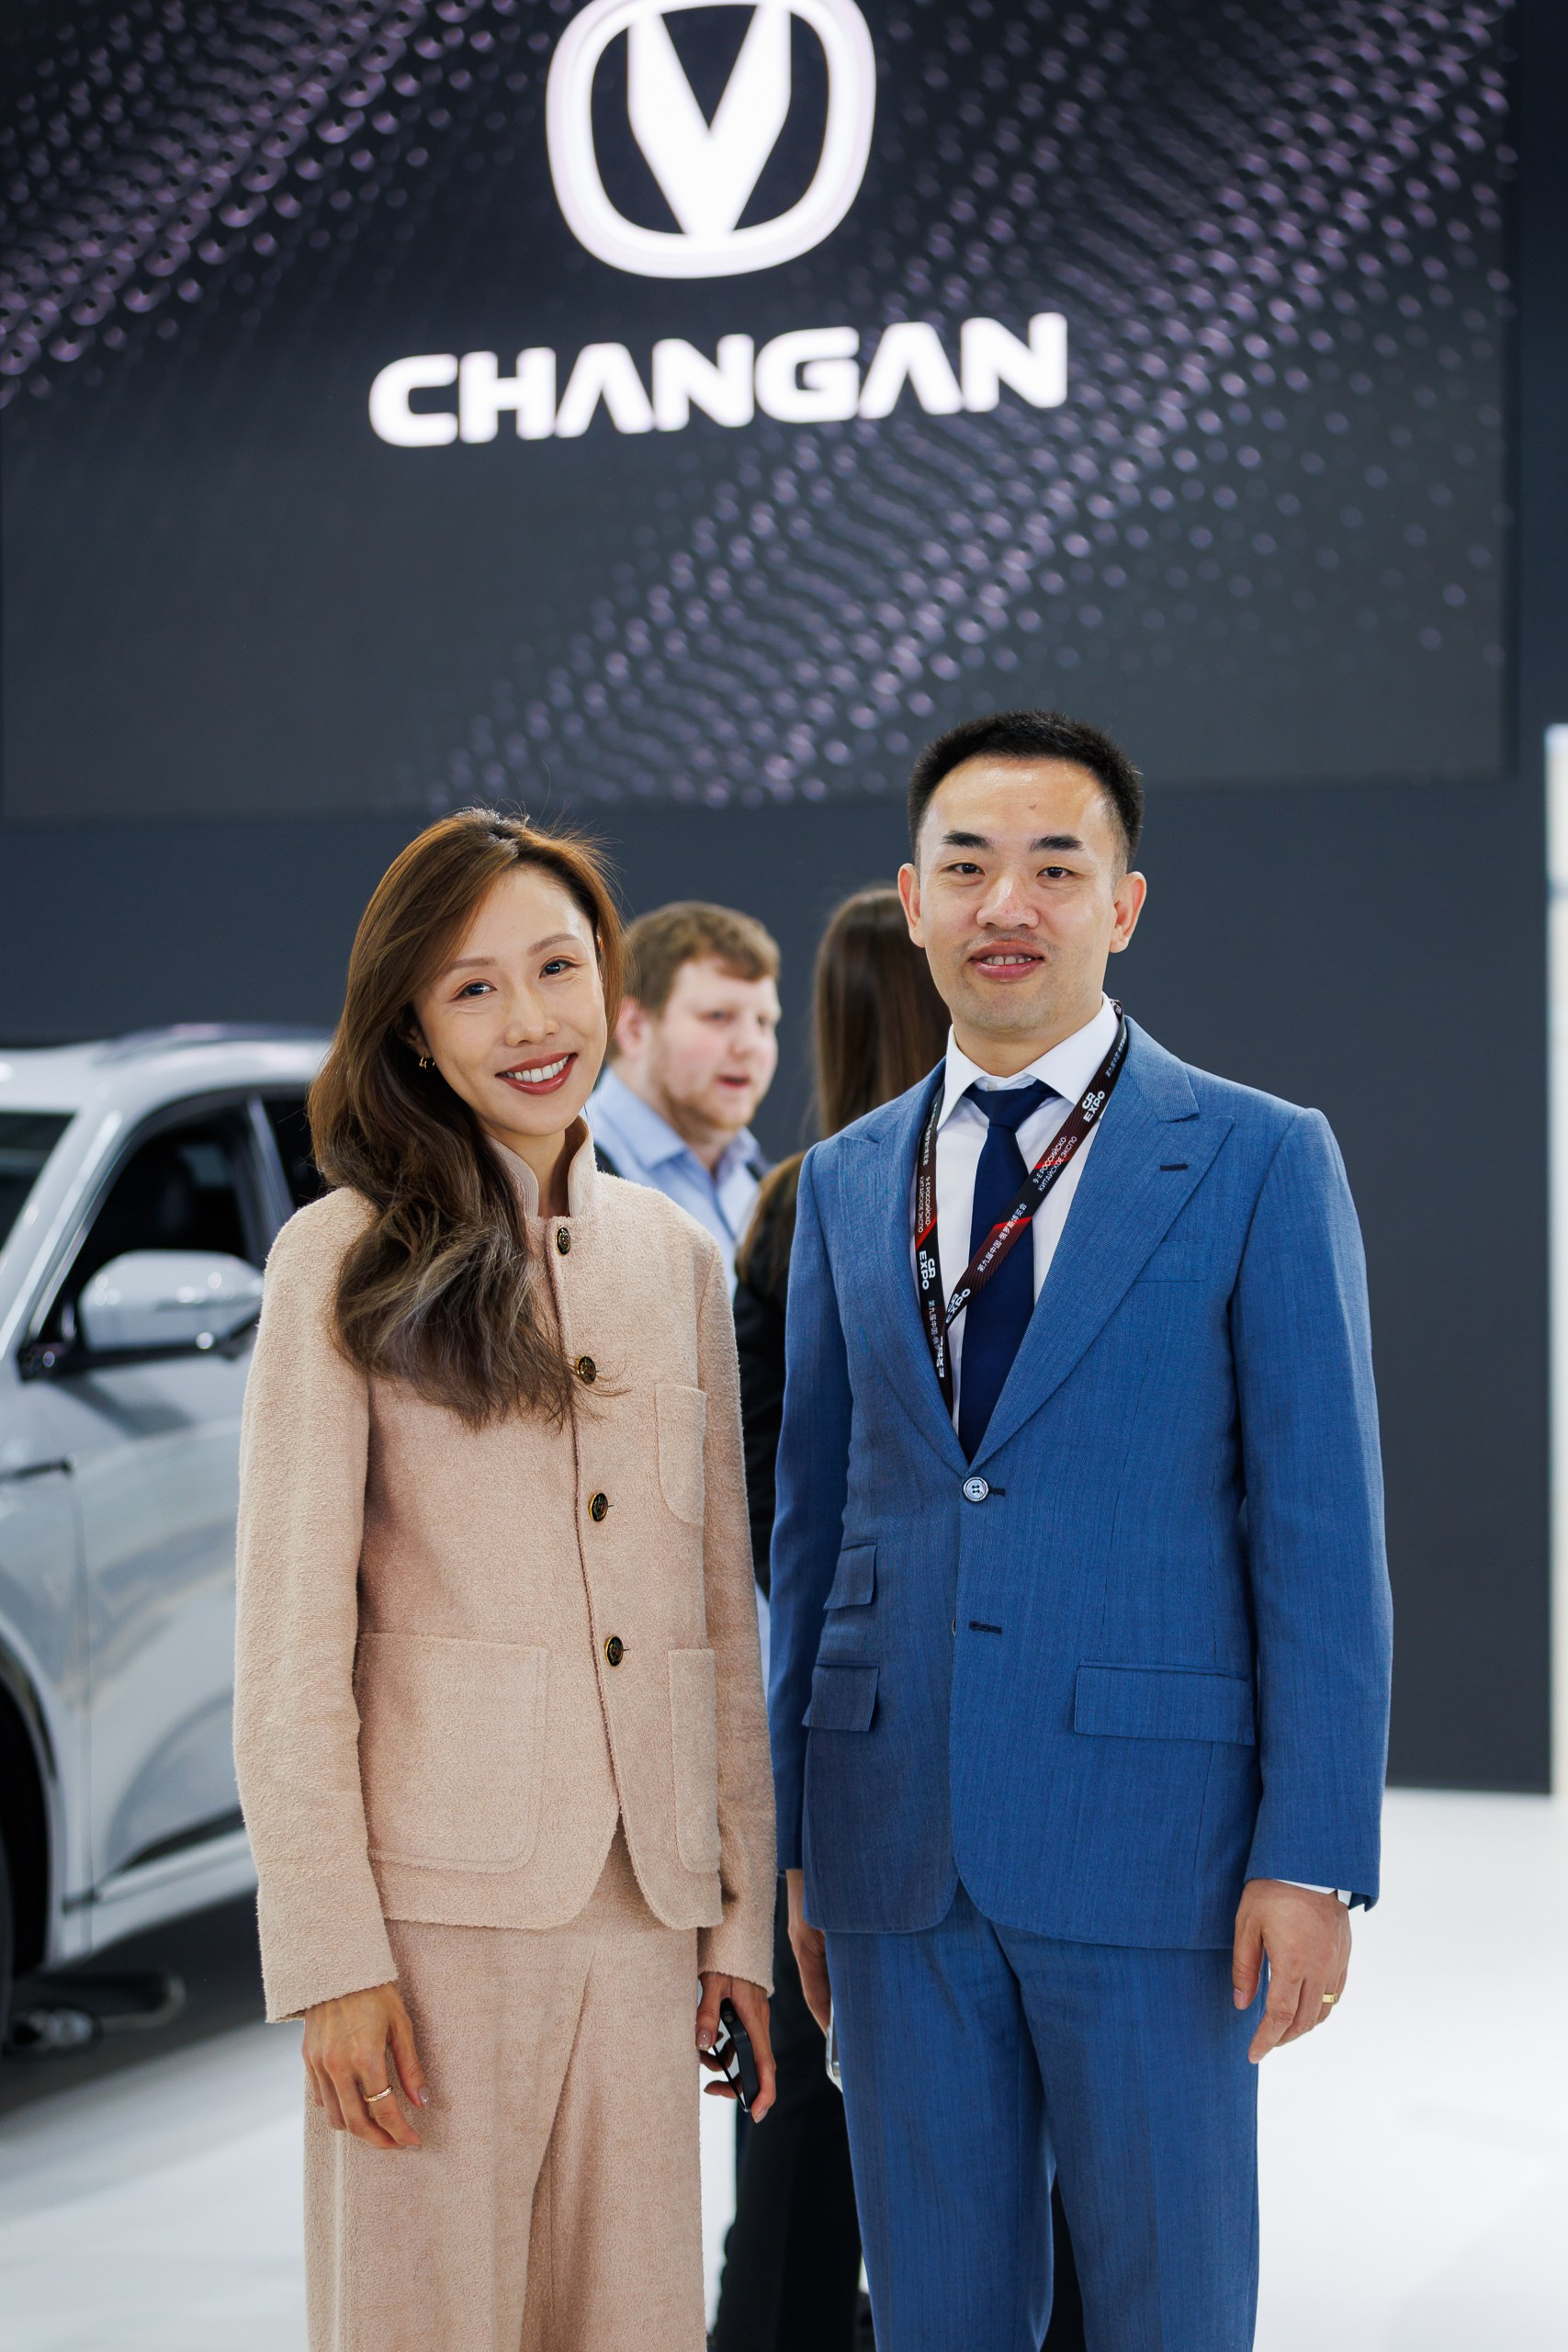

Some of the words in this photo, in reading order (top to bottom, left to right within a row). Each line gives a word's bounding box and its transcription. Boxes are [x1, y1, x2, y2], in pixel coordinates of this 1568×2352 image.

[368, 311, 1068, 448] CHANGAN
[1081, 1091, 1096, 1111] CR
[1083, 1091, 1106, 1123] EXPO
[1038, 1156, 1065, 1193] КИТАЙСКОЕ
[1060, 1136, 1077, 1159] ЭКСПО
[919, 1250, 930, 1290] EXPO
[928, 1258, 936, 1279] CR
